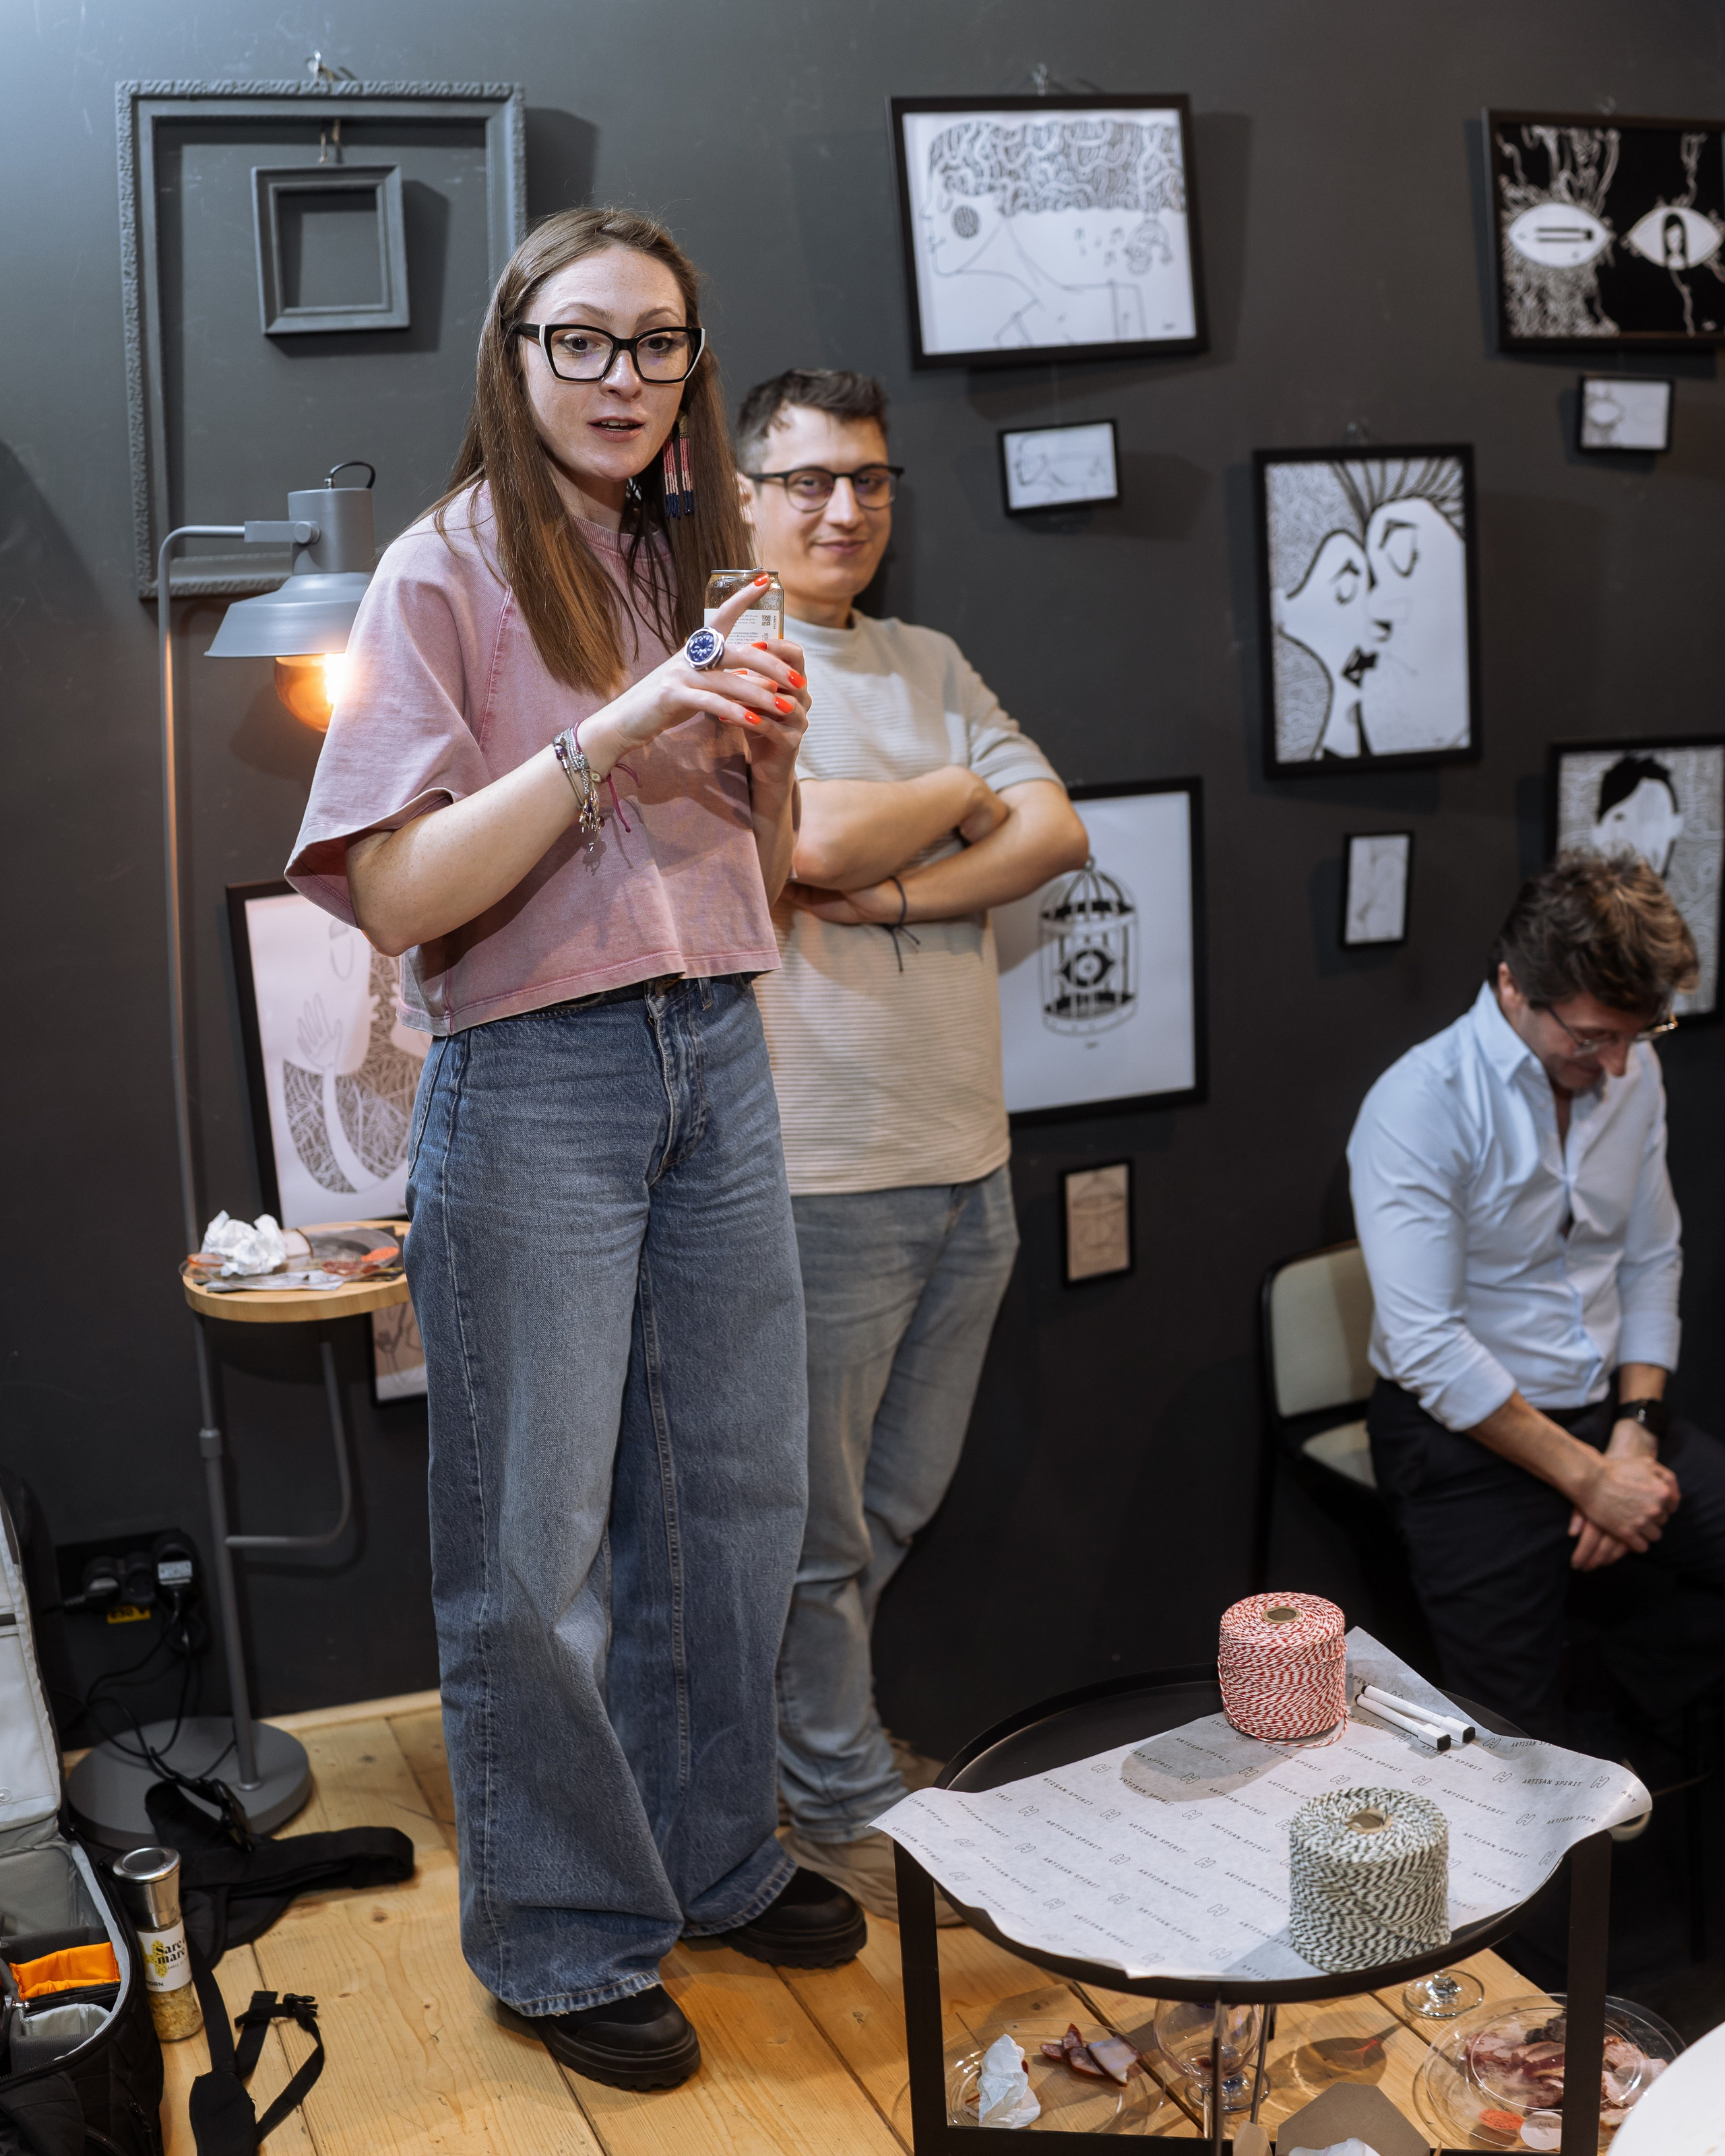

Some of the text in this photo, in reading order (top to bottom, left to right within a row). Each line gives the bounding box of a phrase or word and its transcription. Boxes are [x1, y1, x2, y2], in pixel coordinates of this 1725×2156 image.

[1148, 1756, 1173, 1770] SPIRIT
[1175, 1738, 1231, 1764] ARTISAN SPIRIT
[1263, 1744, 1322, 1772] ARTISAN SPIRIT
[1342, 1746, 1403, 1773] ARTISAN SPIRIT
[1455, 1758, 1482, 1771] SPIRIT
[1068, 1792, 1094, 1806] SPIRIT
[1118, 1776, 1174, 1806] ARTISAN SPIRIT
[1267, 1780, 1298, 1795] ARTISAN
[1208, 1787, 1267, 1816] ARTISAN SPIRIT
[1441, 1788, 1506, 1815] ARTISAN SPIRIT
[926, 1808, 949, 1828] SPIRIT
[957, 1800, 1009, 1839] ARTISAN SPIRIT
[1546, 1816, 1574, 1825] ARTISAN
[891, 1826, 943, 1863] ARTISAN SPIRIT
[1046, 1820, 1102, 1851] ARTISAN SPIRIT
[1128, 1822, 1187, 1853] ARTISAN SPIRIT
[1210, 1823, 1271, 1853] ARTISAN SPIRIT
[1462, 1832, 1529, 1859] ARTISAN SPIRIT
[981, 1856, 1037, 1894] ARTISAN SPIRIT
[1042, 1857, 1100, 1889] ARTISAN SPIRIT
[1137, 1869, 1199, 1899] ARTISAN SPIRIT
[1472, 1872, 1507, 1889] ARTISAN
[1224, 1872, 1287, 1904] ARTISAN SPIRIT
[1073, 1914, 1104, 1932] ARTISAN
[1137, 1907, 1170, 1926] ARTISAN
[156, 1940, 181, 1956] Sare
[157, 1947, 185, 1964] mare
